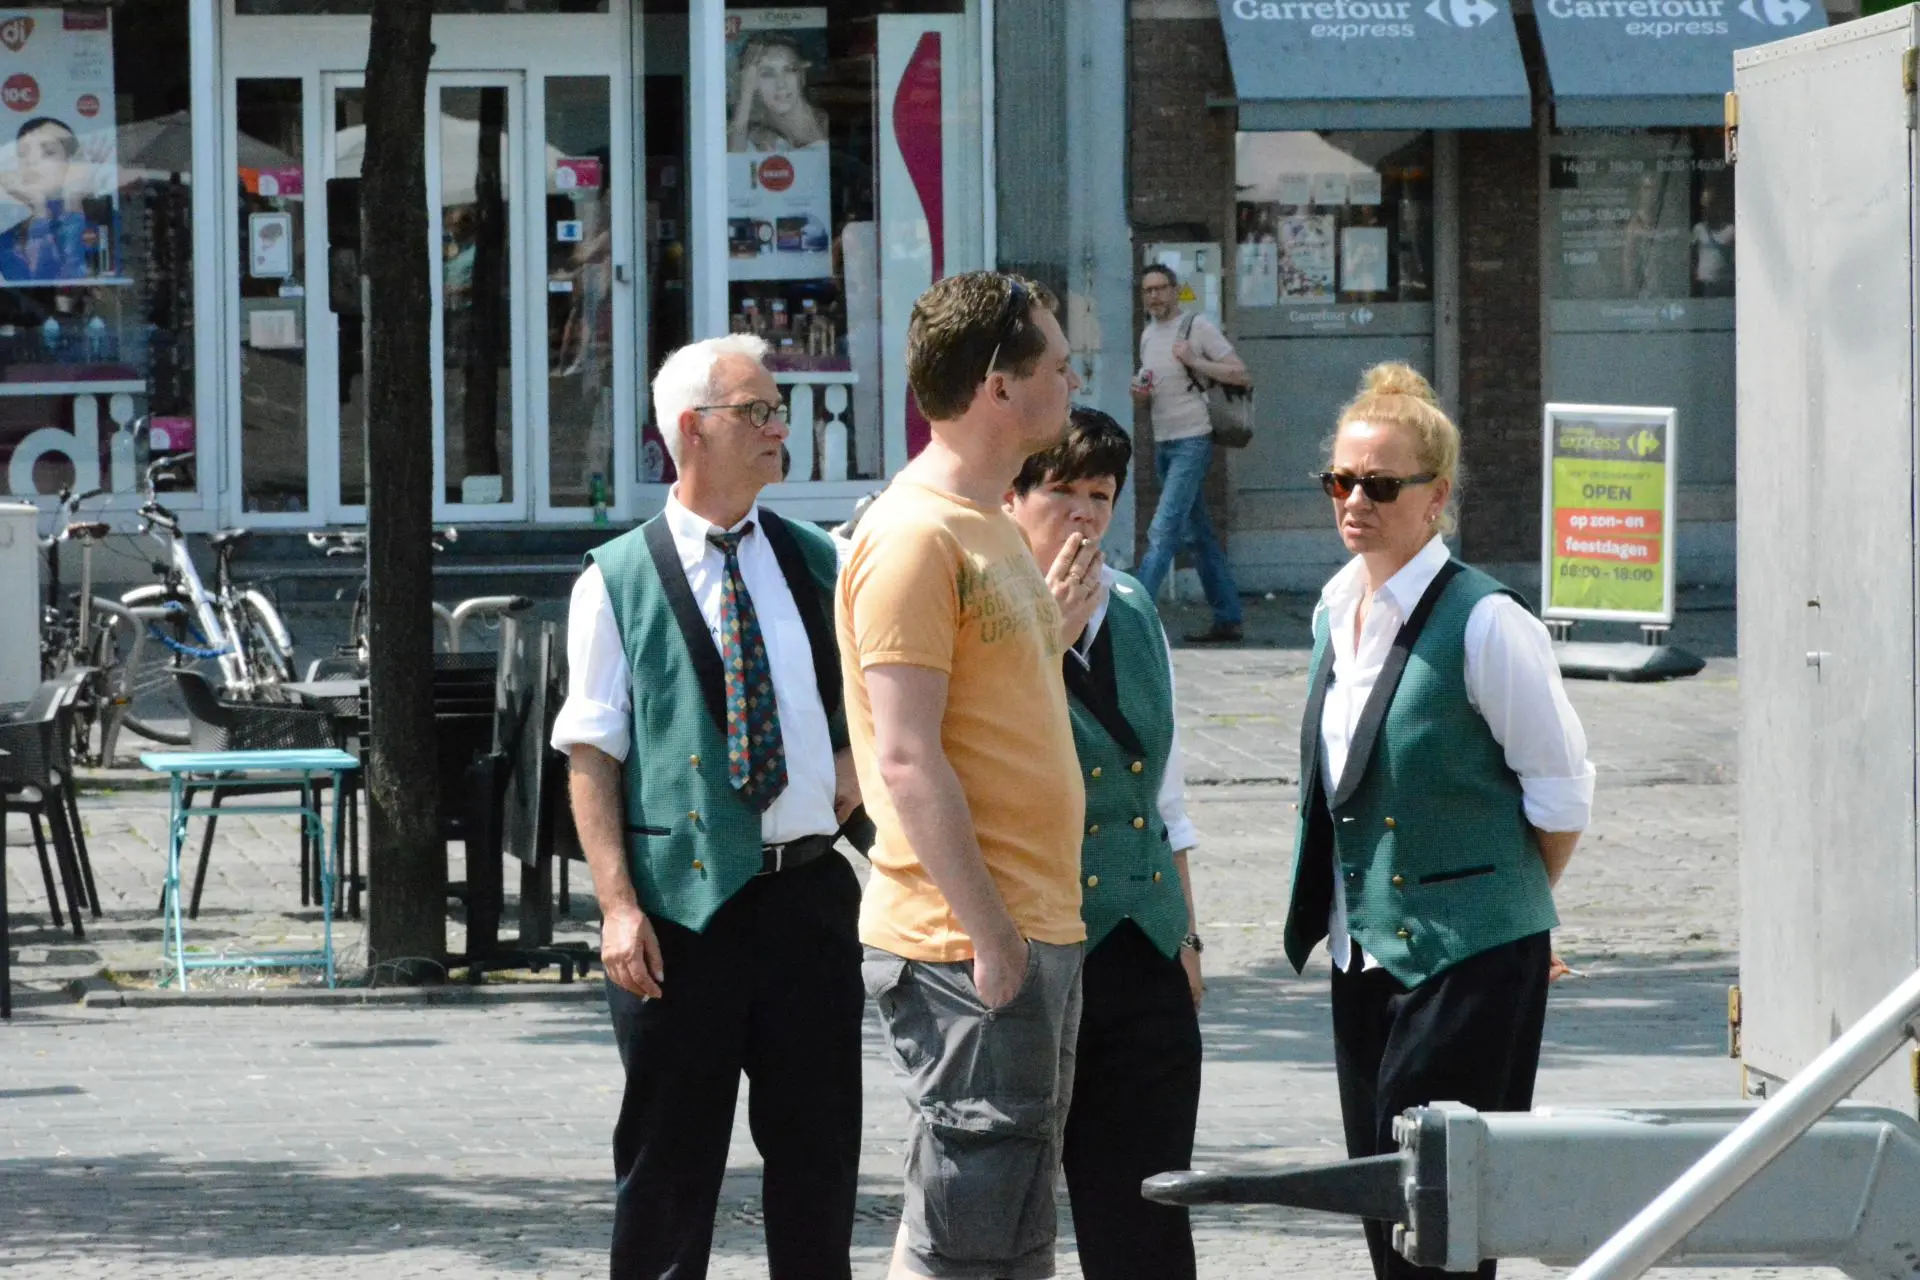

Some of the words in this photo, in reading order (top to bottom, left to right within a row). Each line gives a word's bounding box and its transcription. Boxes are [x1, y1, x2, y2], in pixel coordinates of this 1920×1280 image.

[1232, 0, 1411, 20] Carrefour
[1547, 0, 1724, 18] Carrefour
[1310, 23, 1415, 41] express
[1625, 20, 1729, 38] express
[1582, 484, 1632, 501] OPEN
[1569, 515, 1588, 530] op
[1590, 515, 1623, 528] zon-
[1624, 515, 1645, 529] en
[1565, 536, 1648, 560] feestdagen
